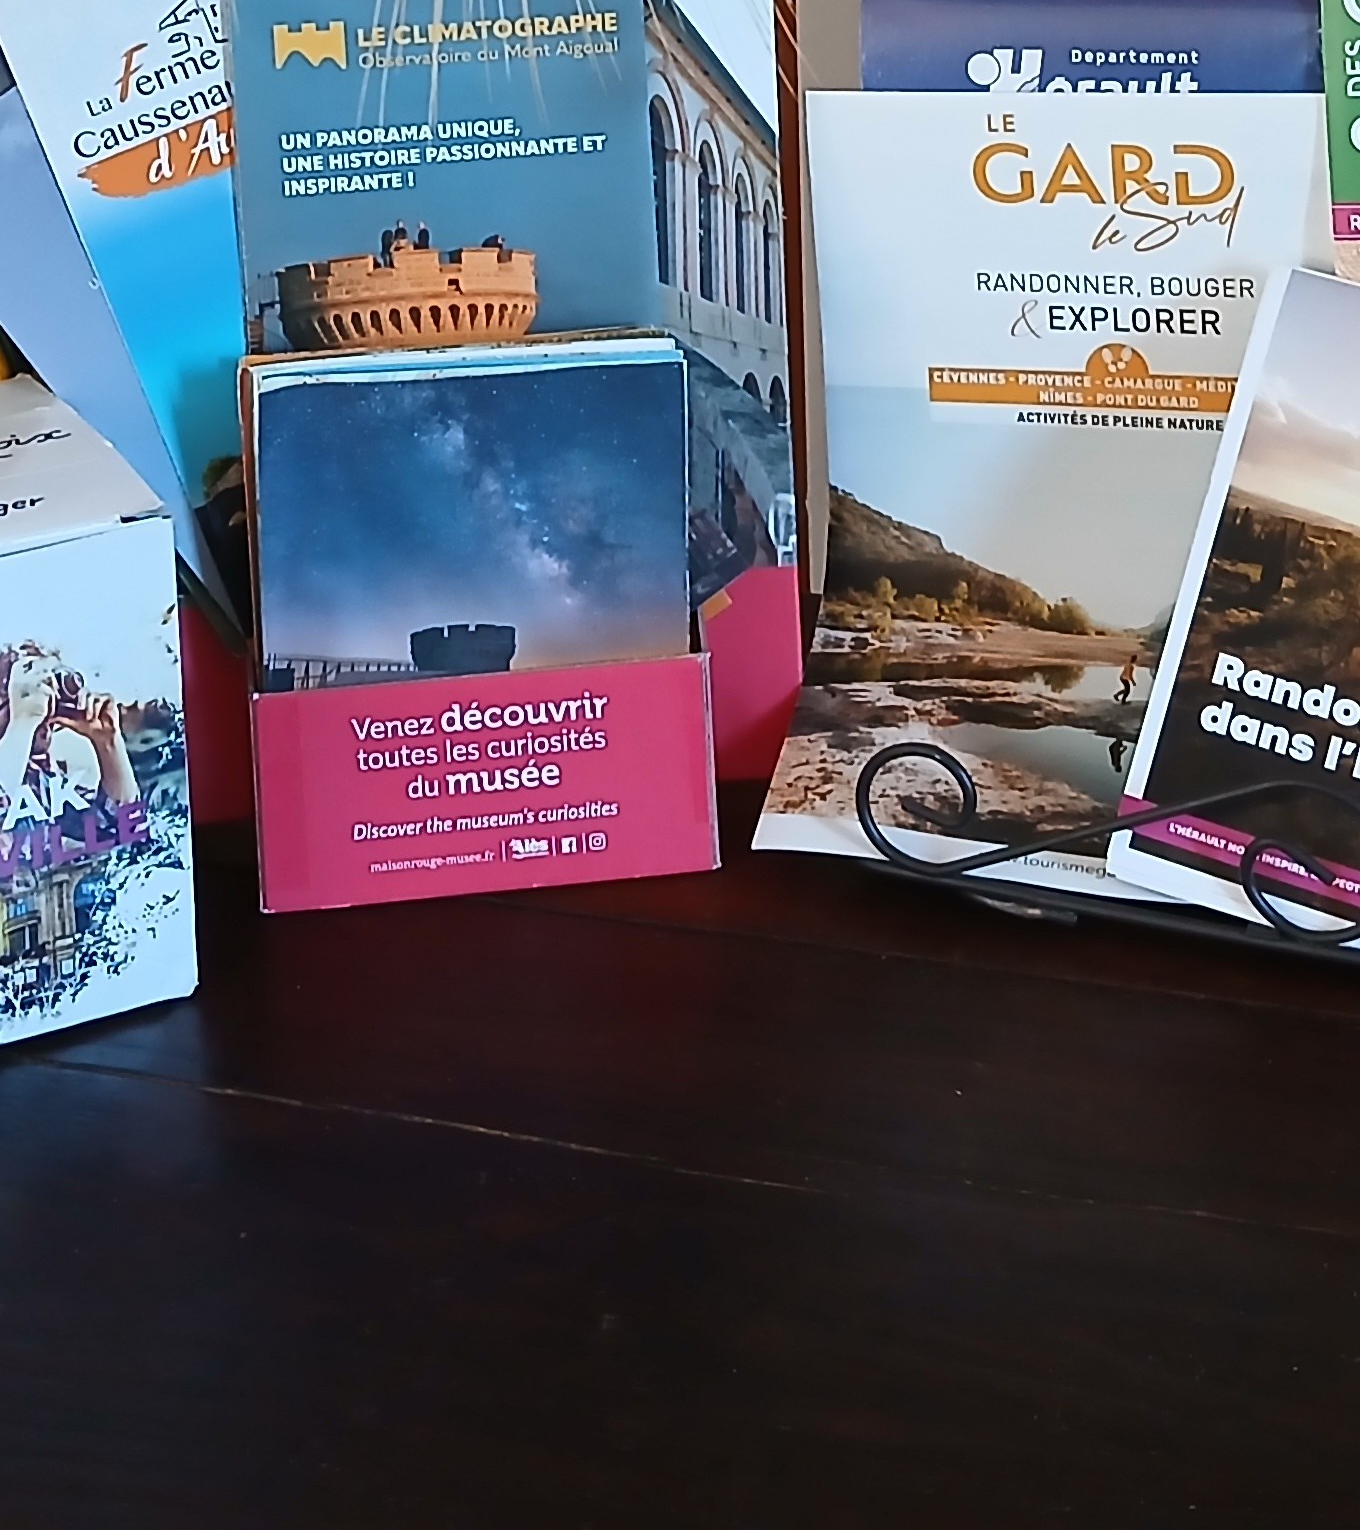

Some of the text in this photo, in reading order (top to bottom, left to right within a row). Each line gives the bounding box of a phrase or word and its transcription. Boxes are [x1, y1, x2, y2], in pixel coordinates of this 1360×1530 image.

[357, 12, 618, 48] LE CLIMATOGRAPHE
[477, 42, 499, 62] du
[556, 36, 619, 61] Aigoual
[86, 42, 220, 117] La Ferme
[281, 117, 521, 151] UN PANORAMA UNIQUE,
[987, 113, 1015, 132] LE
[282, 134, 606, 174] UNE HISTOIRE PASSIONNANTE ET
[282, 171, 403, 197] INSPIRANTE
[973, 142, 1235, 206] GARD
[1120, 182, 1244, 252] Sud
[976, 272, 1255, 299] RANDONNER, BOUGER
[1048, 305, 1221, 336] EXPLORER
[933, 368, 1006, 385] CÉVENNES
[1018, 373, 1091, 388] PROVENCE
[1104, 377, 1182, 392] CAMARGUE
[1039, 388, 1199, 409] NÎMES PONT DU GARD
[1016, 409, 1224, 432] ACTIVITÉS DE PLEINE NATURE
[350, 691, 609, 741] Venez découvrir
[1200, 701, 1316, 763] dans
[356, 727, 606, 772] toutes les curiosités
[407, 761, 561, 800] du musée
[352, 799, 619, 842] Discover the museum's curiosities
